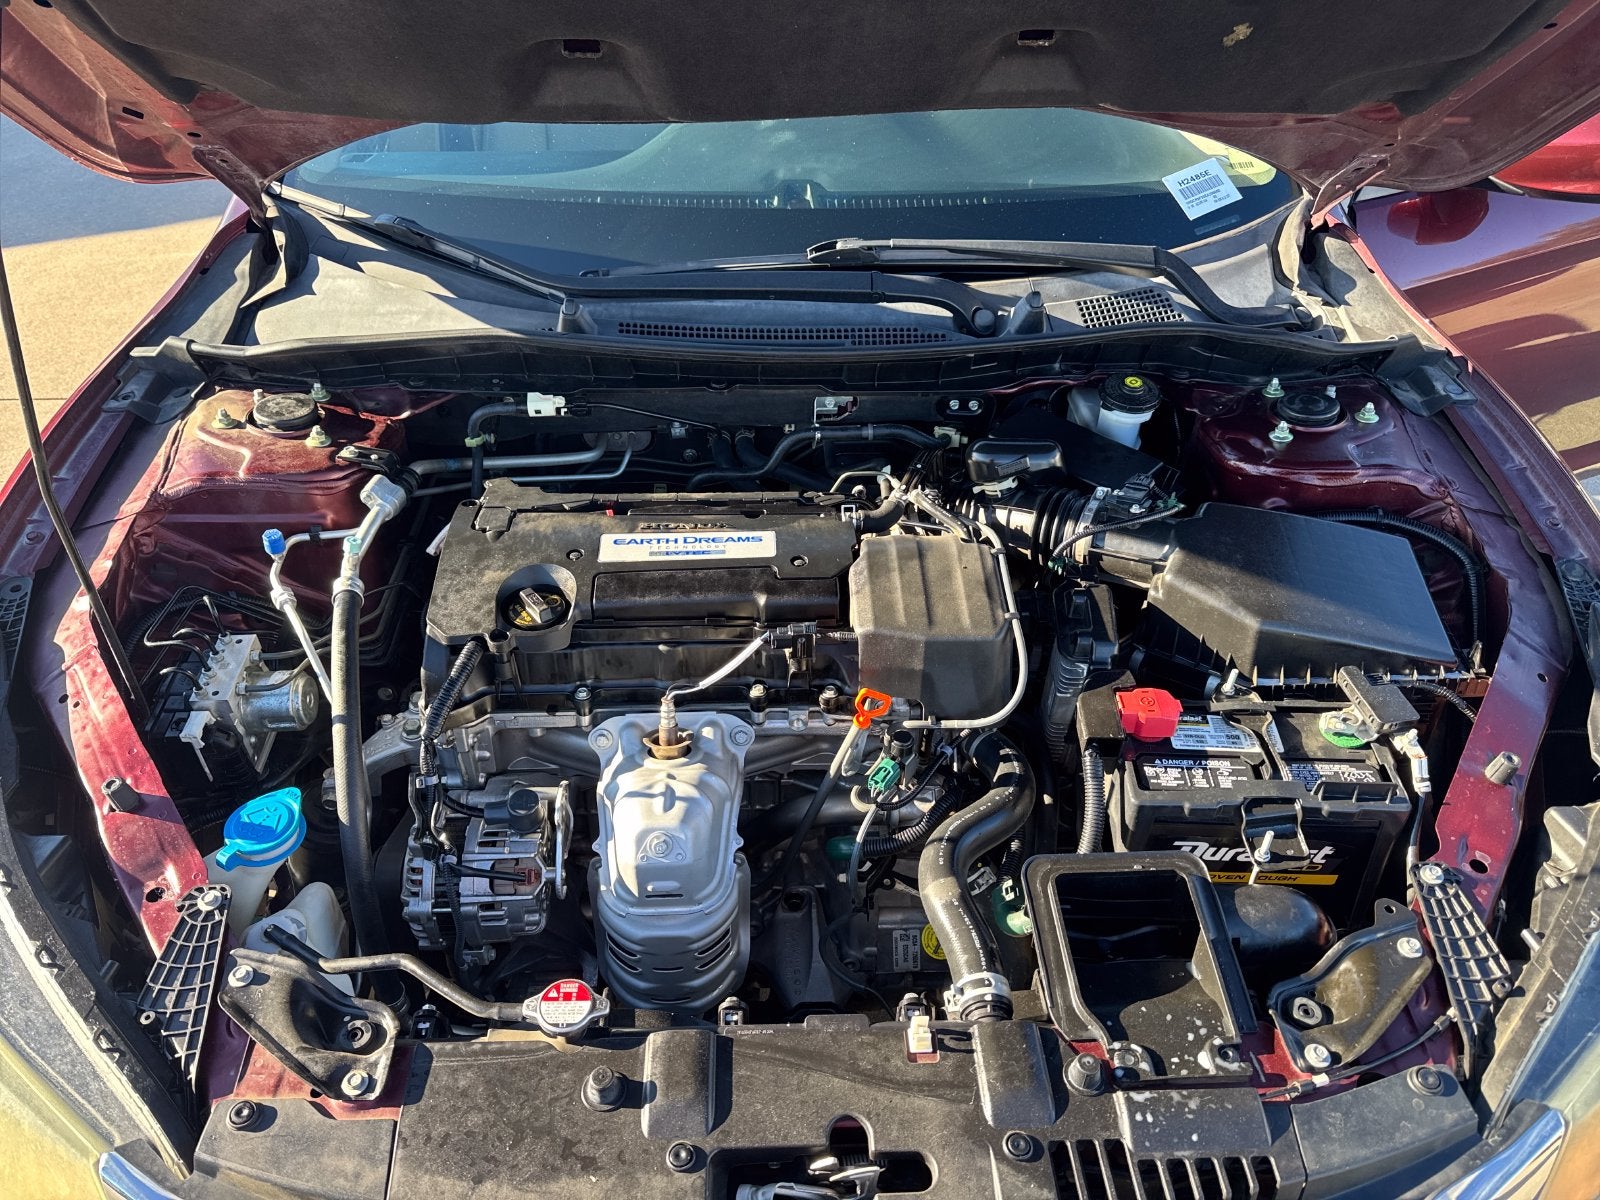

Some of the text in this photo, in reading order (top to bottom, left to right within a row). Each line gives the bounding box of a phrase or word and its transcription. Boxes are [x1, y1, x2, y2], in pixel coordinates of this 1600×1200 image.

[613, 536, 763, 545] EARTH DREAMS
[1172, 841, 1336, 864] Durat
